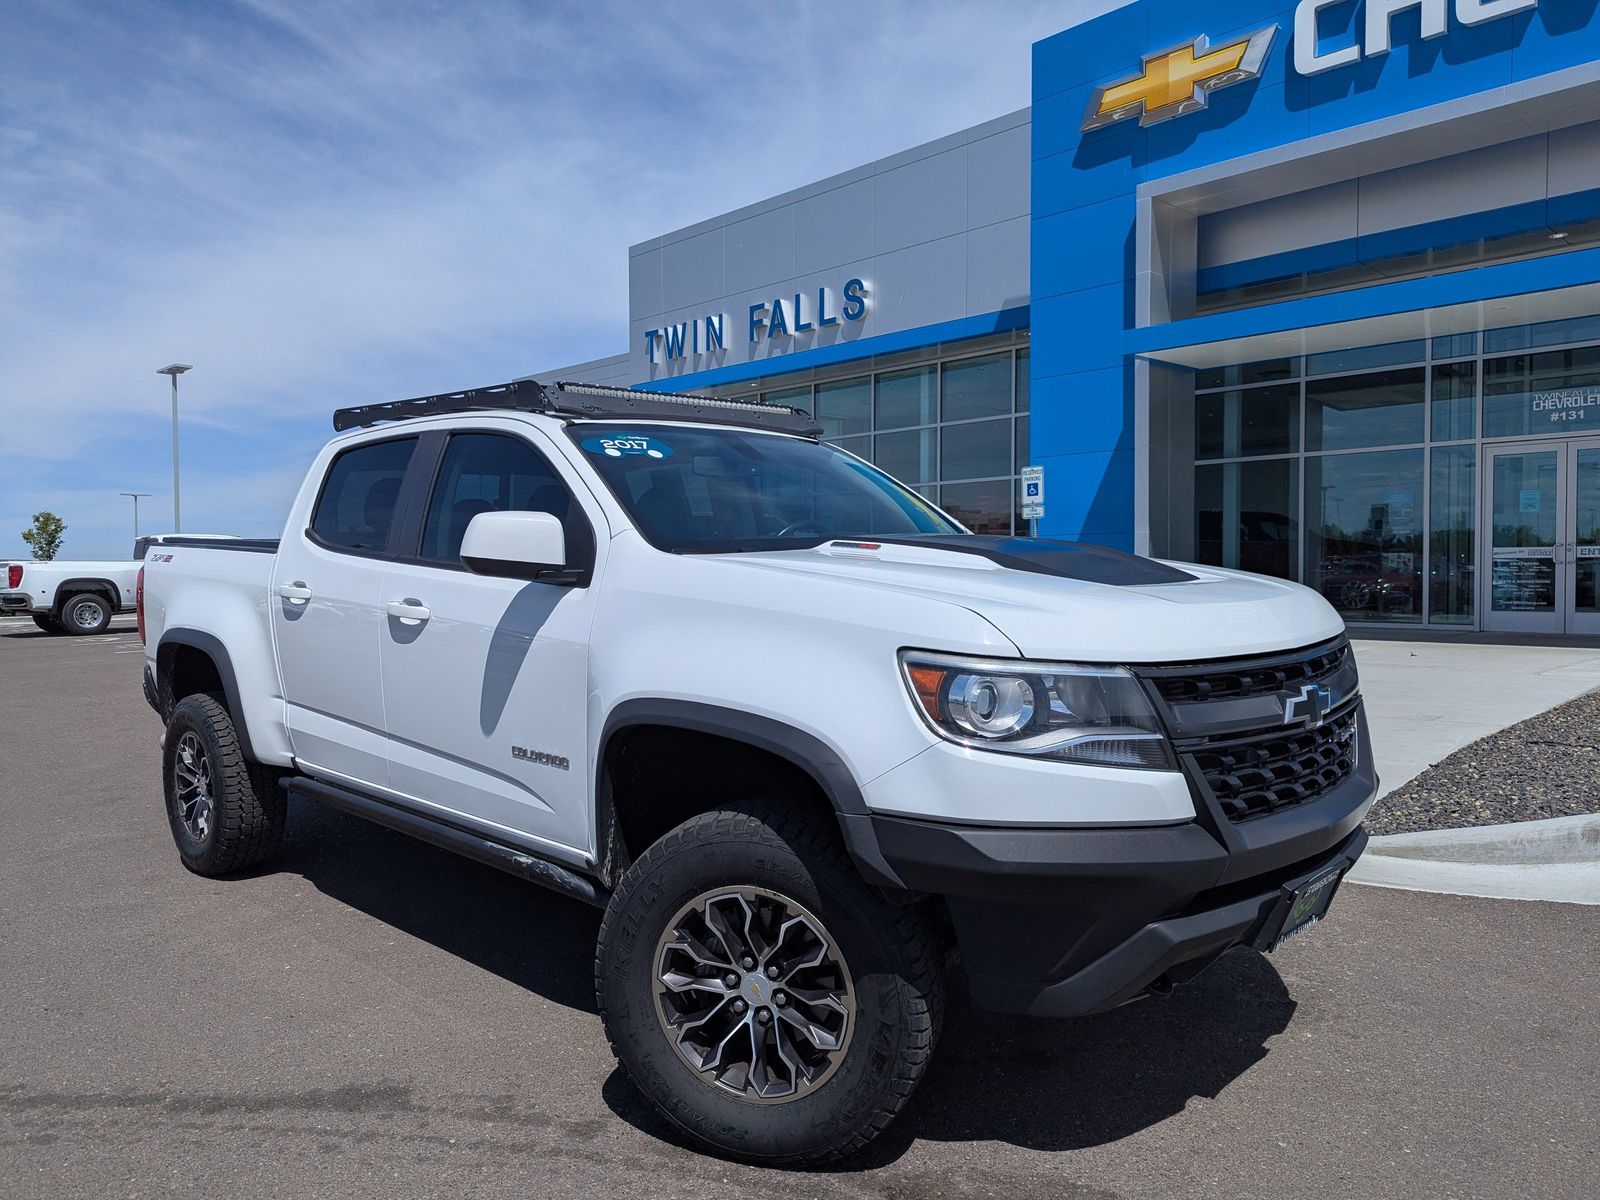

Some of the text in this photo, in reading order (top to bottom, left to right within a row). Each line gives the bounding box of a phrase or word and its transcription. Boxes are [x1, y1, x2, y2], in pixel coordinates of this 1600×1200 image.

[1294, 0, 1538, 76] CH
[645, 278, 870, 363] TWIN FALLS
[1533, 395, 1600, 410] CHEVROLET
[1551, 410, 1584, 421] #131
[600, 440, 648, 449] 2017
[512, 746, 570, 769] COLORADO
[614, 871, 668, 981] KELLY
